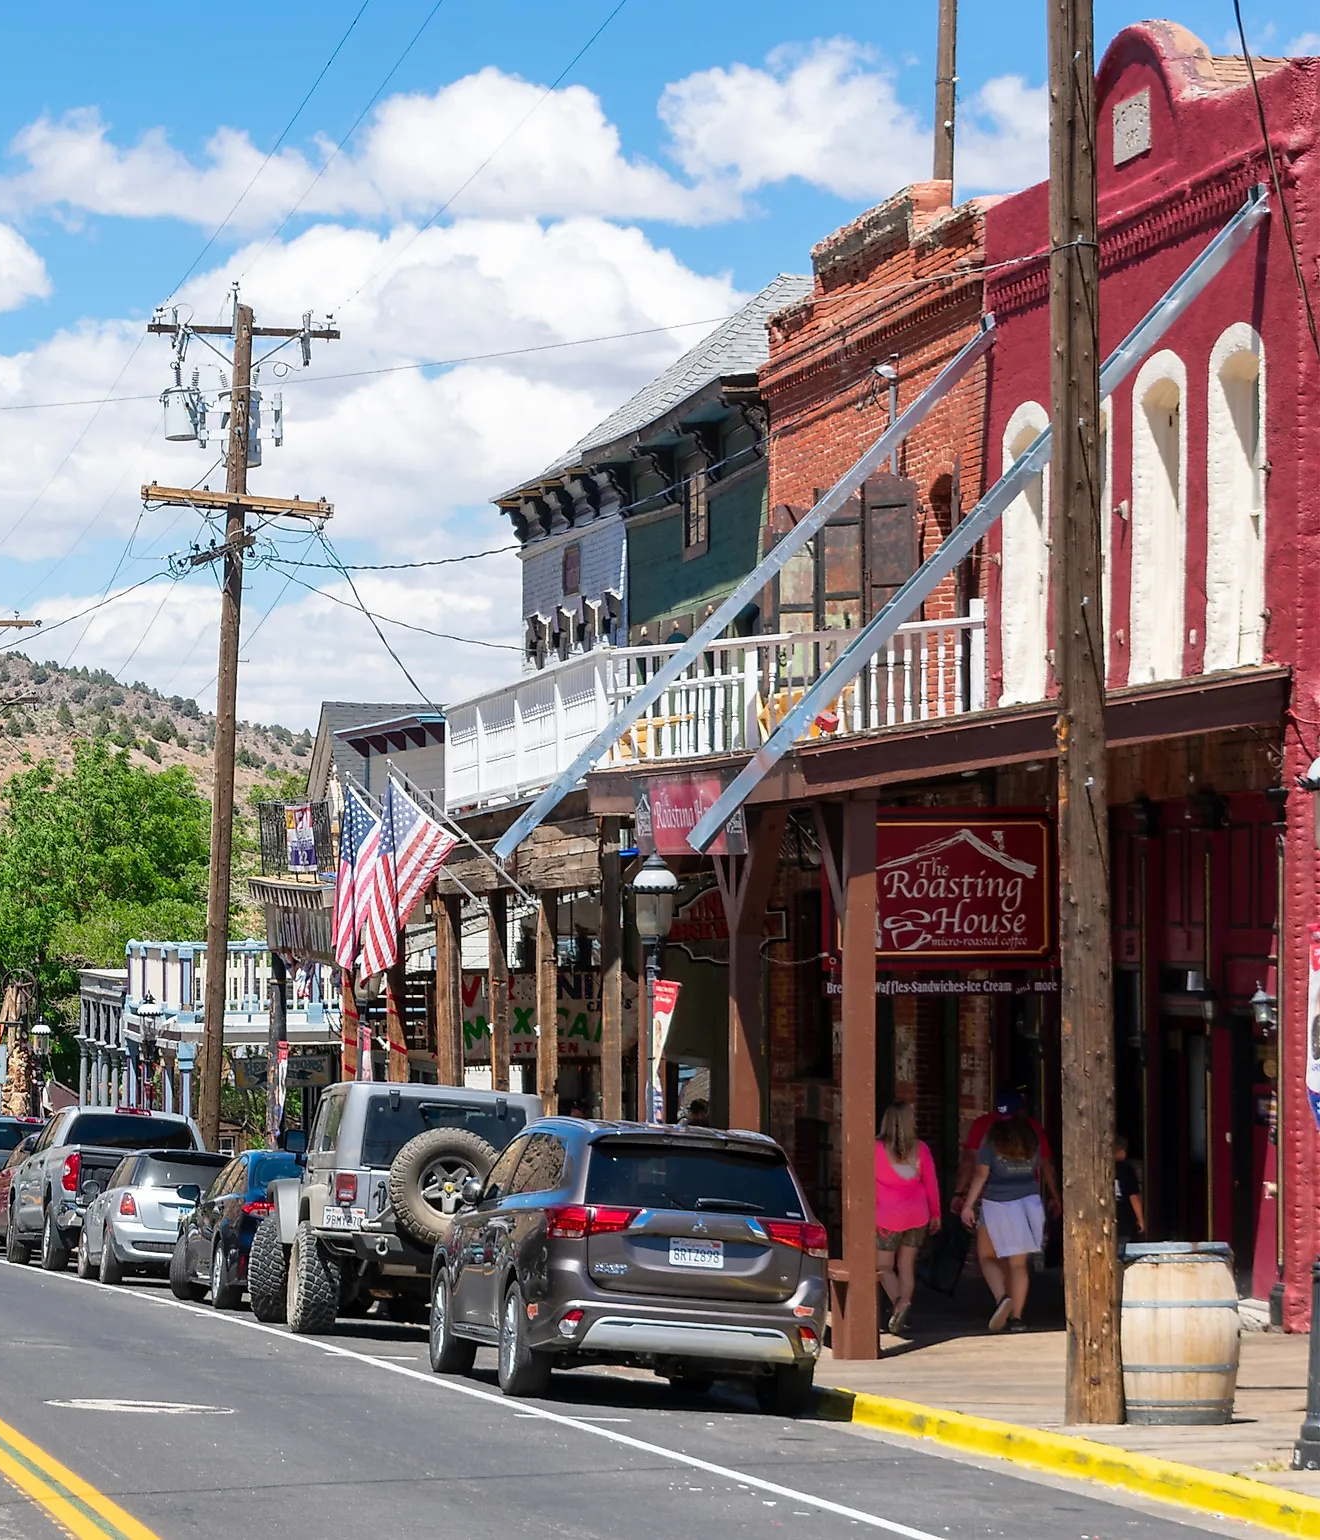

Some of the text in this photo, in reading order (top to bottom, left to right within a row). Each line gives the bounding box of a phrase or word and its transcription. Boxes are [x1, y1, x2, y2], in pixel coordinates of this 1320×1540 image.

[916, 857, 950, 877] The
[883, 870, 1023, 912] Roasting
[931, 898, 1026, 934] House
[931, 934, 1028, 950] micro-roasted coffee
[983, 980, 1012, 993] Cream
[1034, 981, 1058, 992] more
